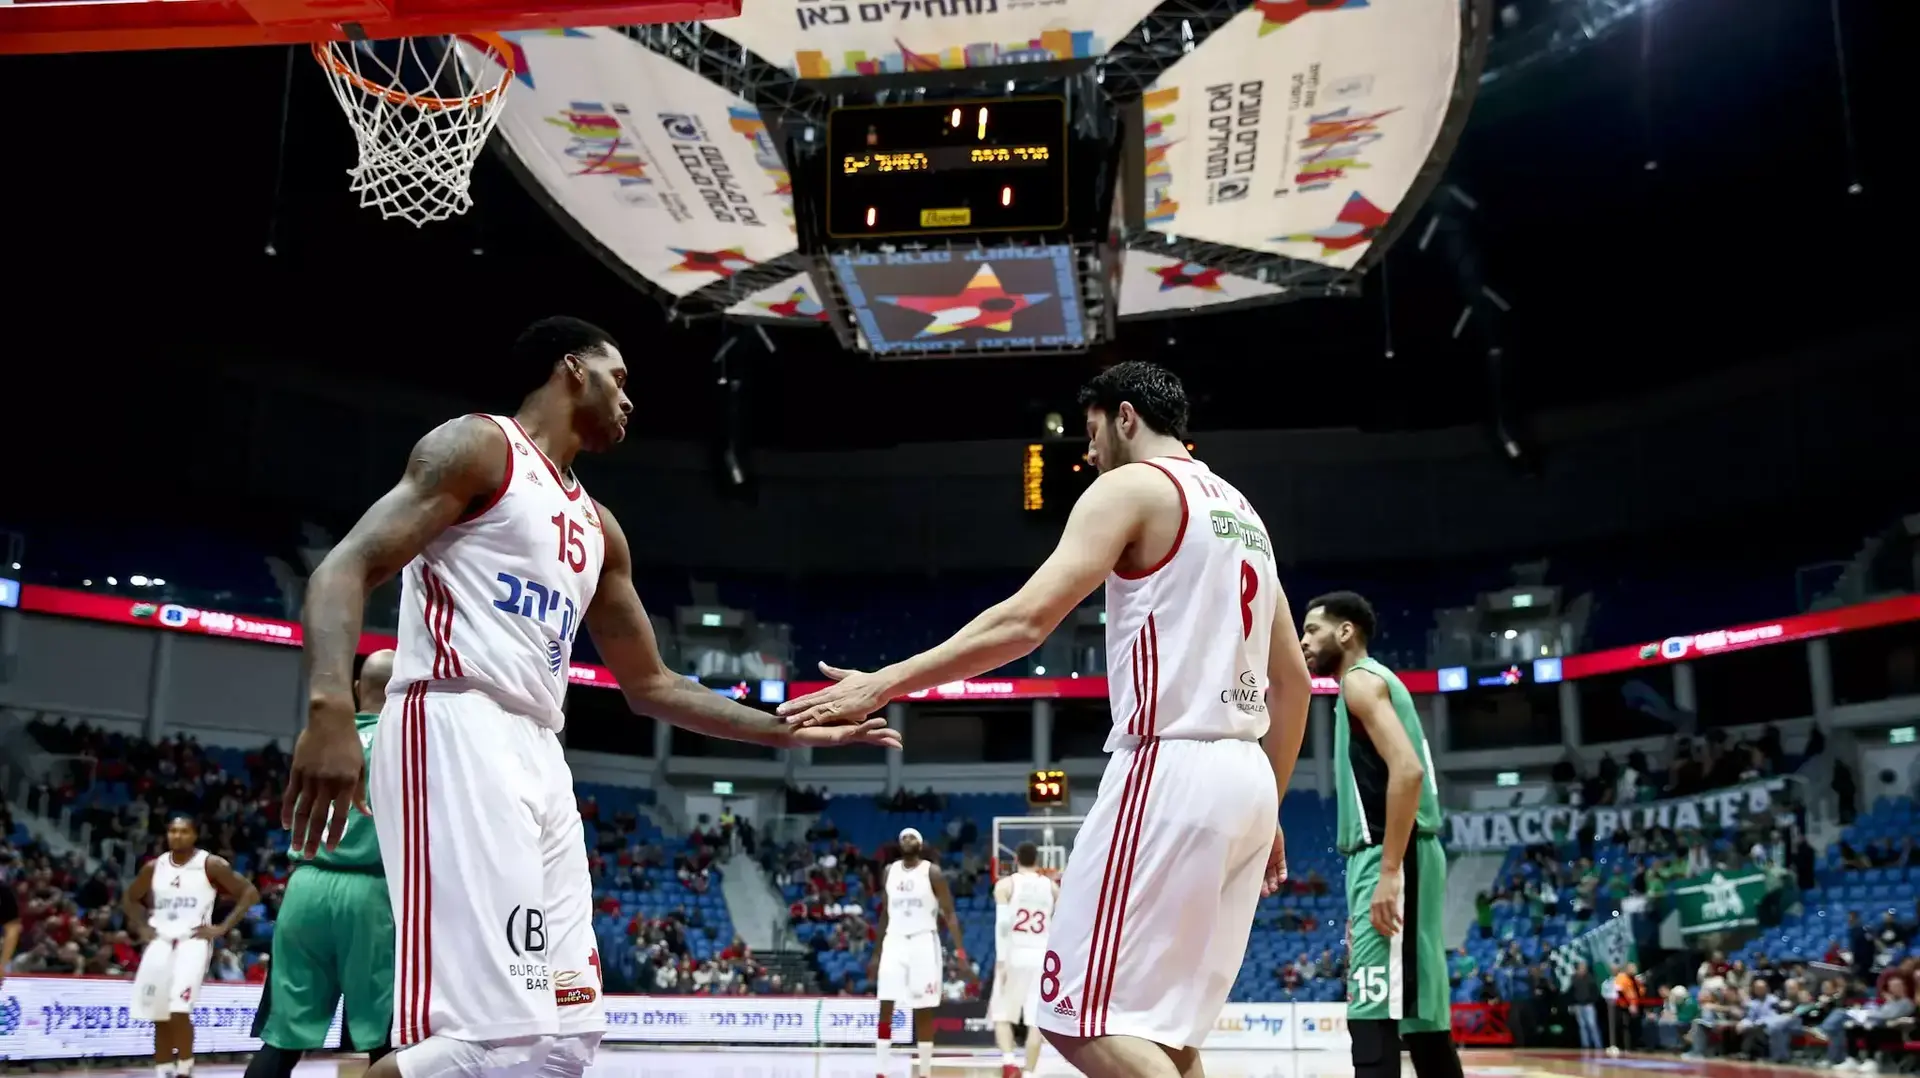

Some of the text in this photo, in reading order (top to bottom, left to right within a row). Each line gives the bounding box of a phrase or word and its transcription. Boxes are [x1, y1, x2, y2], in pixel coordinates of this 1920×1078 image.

[796, 6, 850, 31] כאן
[1205, 83, 1233, 179] מתחילים כאן
[1233, 80, 1263, 175] דברים טובים
[551, 511, 587, 574] 15
[493, 572, 561, 623] יהב
[1013, 908, 1046, 934] 23
[509, 964, 549, 977] BURGE
[1041, 950, 1061, 1003] 8
[526, 978, 549, 991] BAR
[1353, 966, 1388, 1003] 15
[741, 1012, 768, 1026] יהב
[773, 1012, 803, 1030] בנק
[829, 1013, 853, 1026] יהב
[1053, 1007, 1077, 1016] adidas
